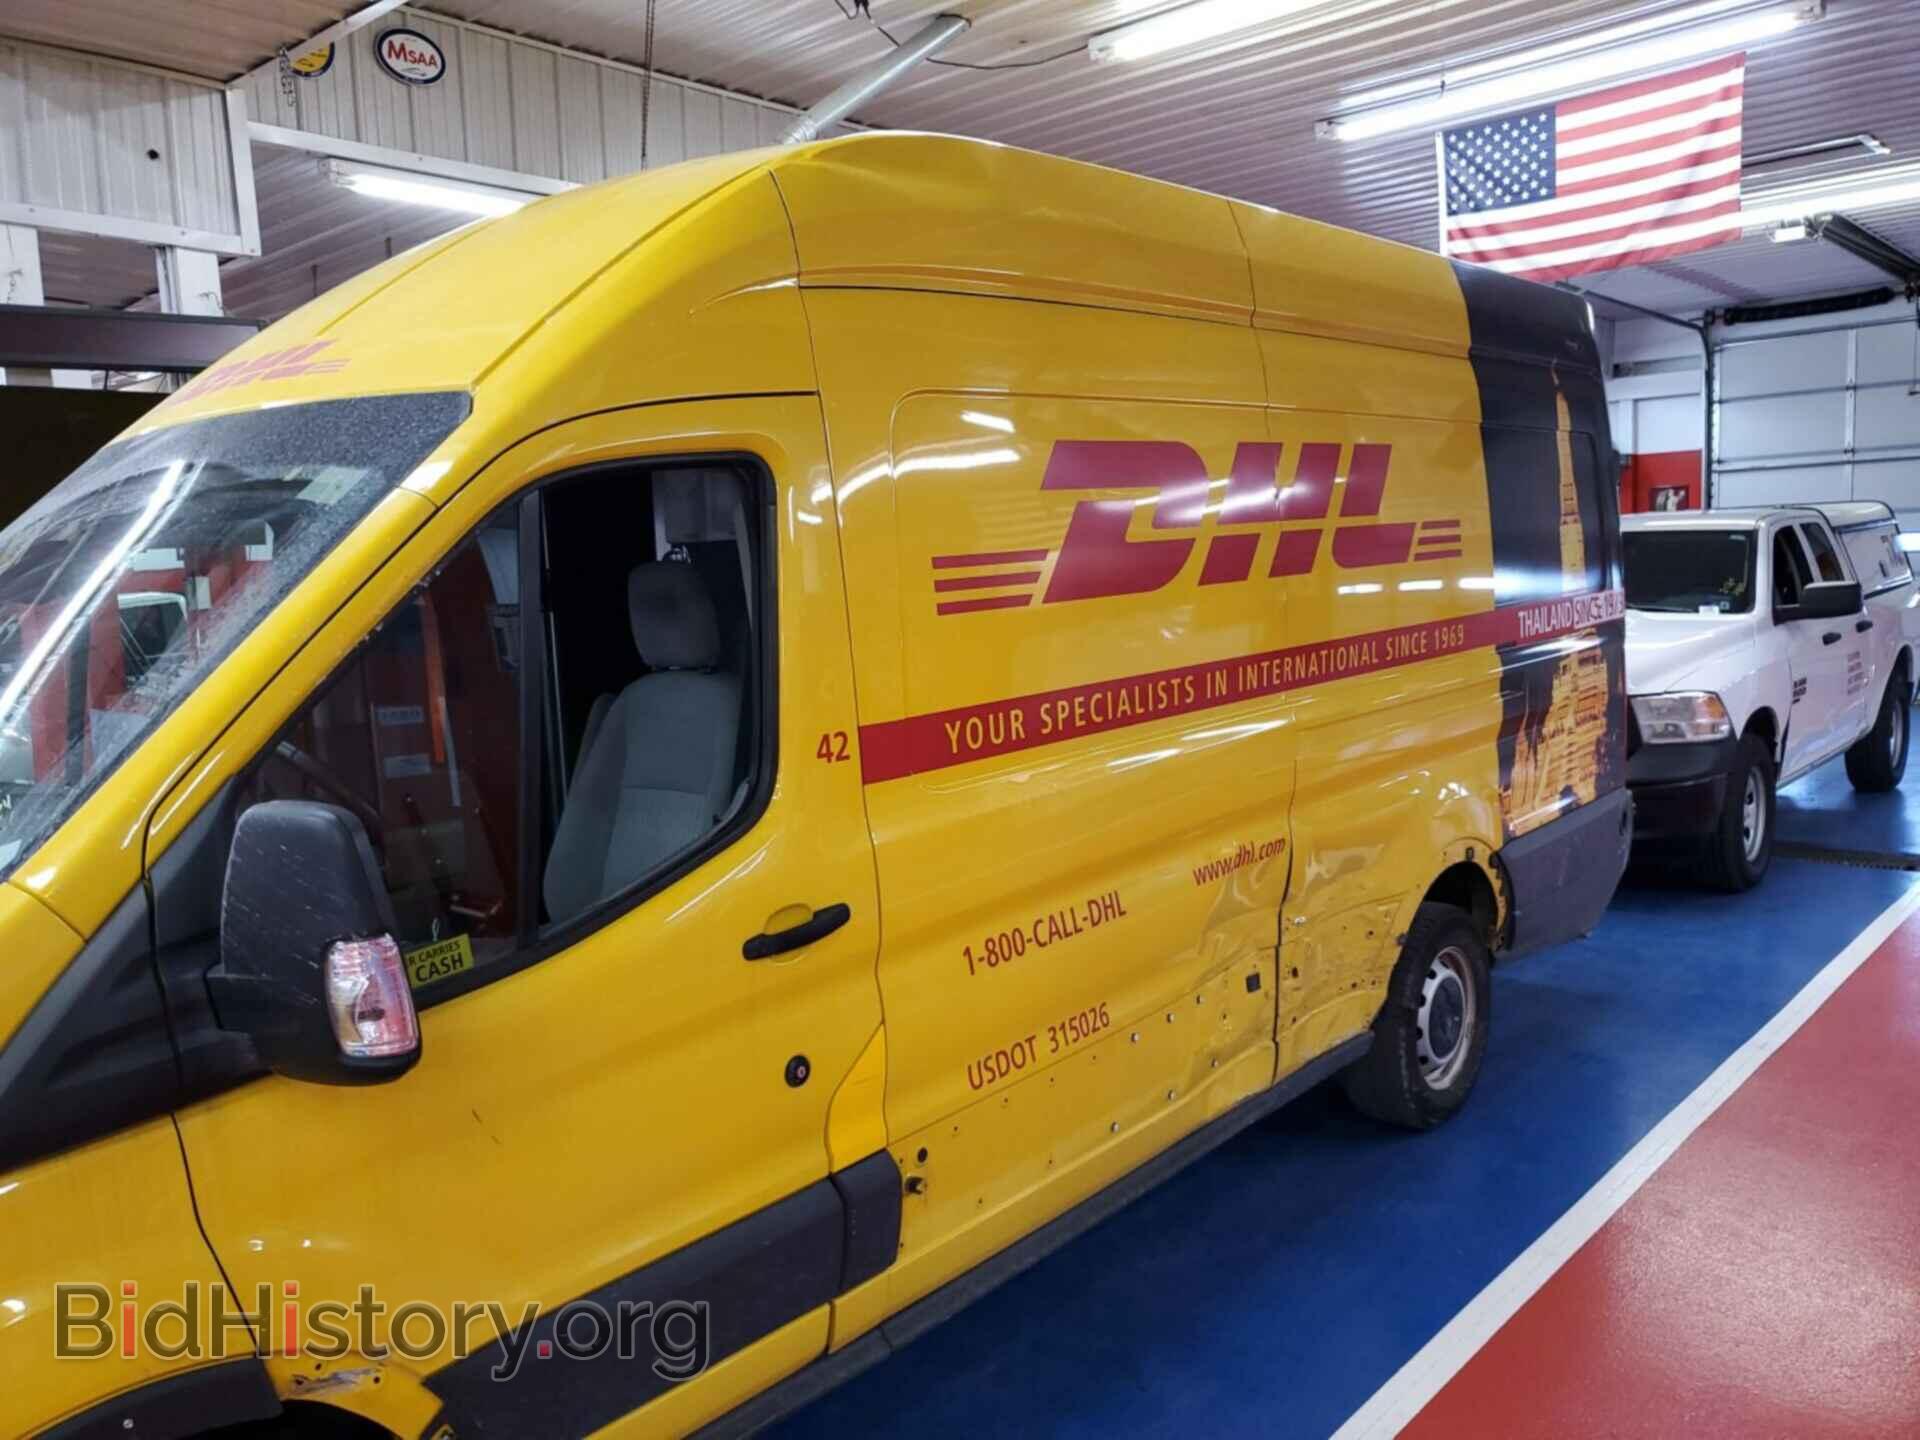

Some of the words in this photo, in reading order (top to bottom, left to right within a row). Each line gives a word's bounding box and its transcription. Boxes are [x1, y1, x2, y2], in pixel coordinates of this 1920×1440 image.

[1040, 440, 1416, 604] DHL
[1518, 602, 1573, 639] THAILAND
[945, 708, 1025, 753] YOUR
[1040, 675, 1194, 734] SPECIALISTS
[1206, 671, 1227, 699] IN
[1238, 646, 1379, 685] INTERNATIONAL
[1385, 631, 1428, 661] SINCE
[1434, 624, 1464, 650] 1969
[816, 731, 850, 763] 42
[1193, 837, 1286, 886] www.dhl.com
[418, 940, 460, 963] CARRIES
[962, 890, 1127, 975] 1-800-CALL-DHL
[416, 951, 464, 982] CASH
[967, 1035, 1037, 1090] USDOT
[1048, 1002, 1110, 1054] 315026
